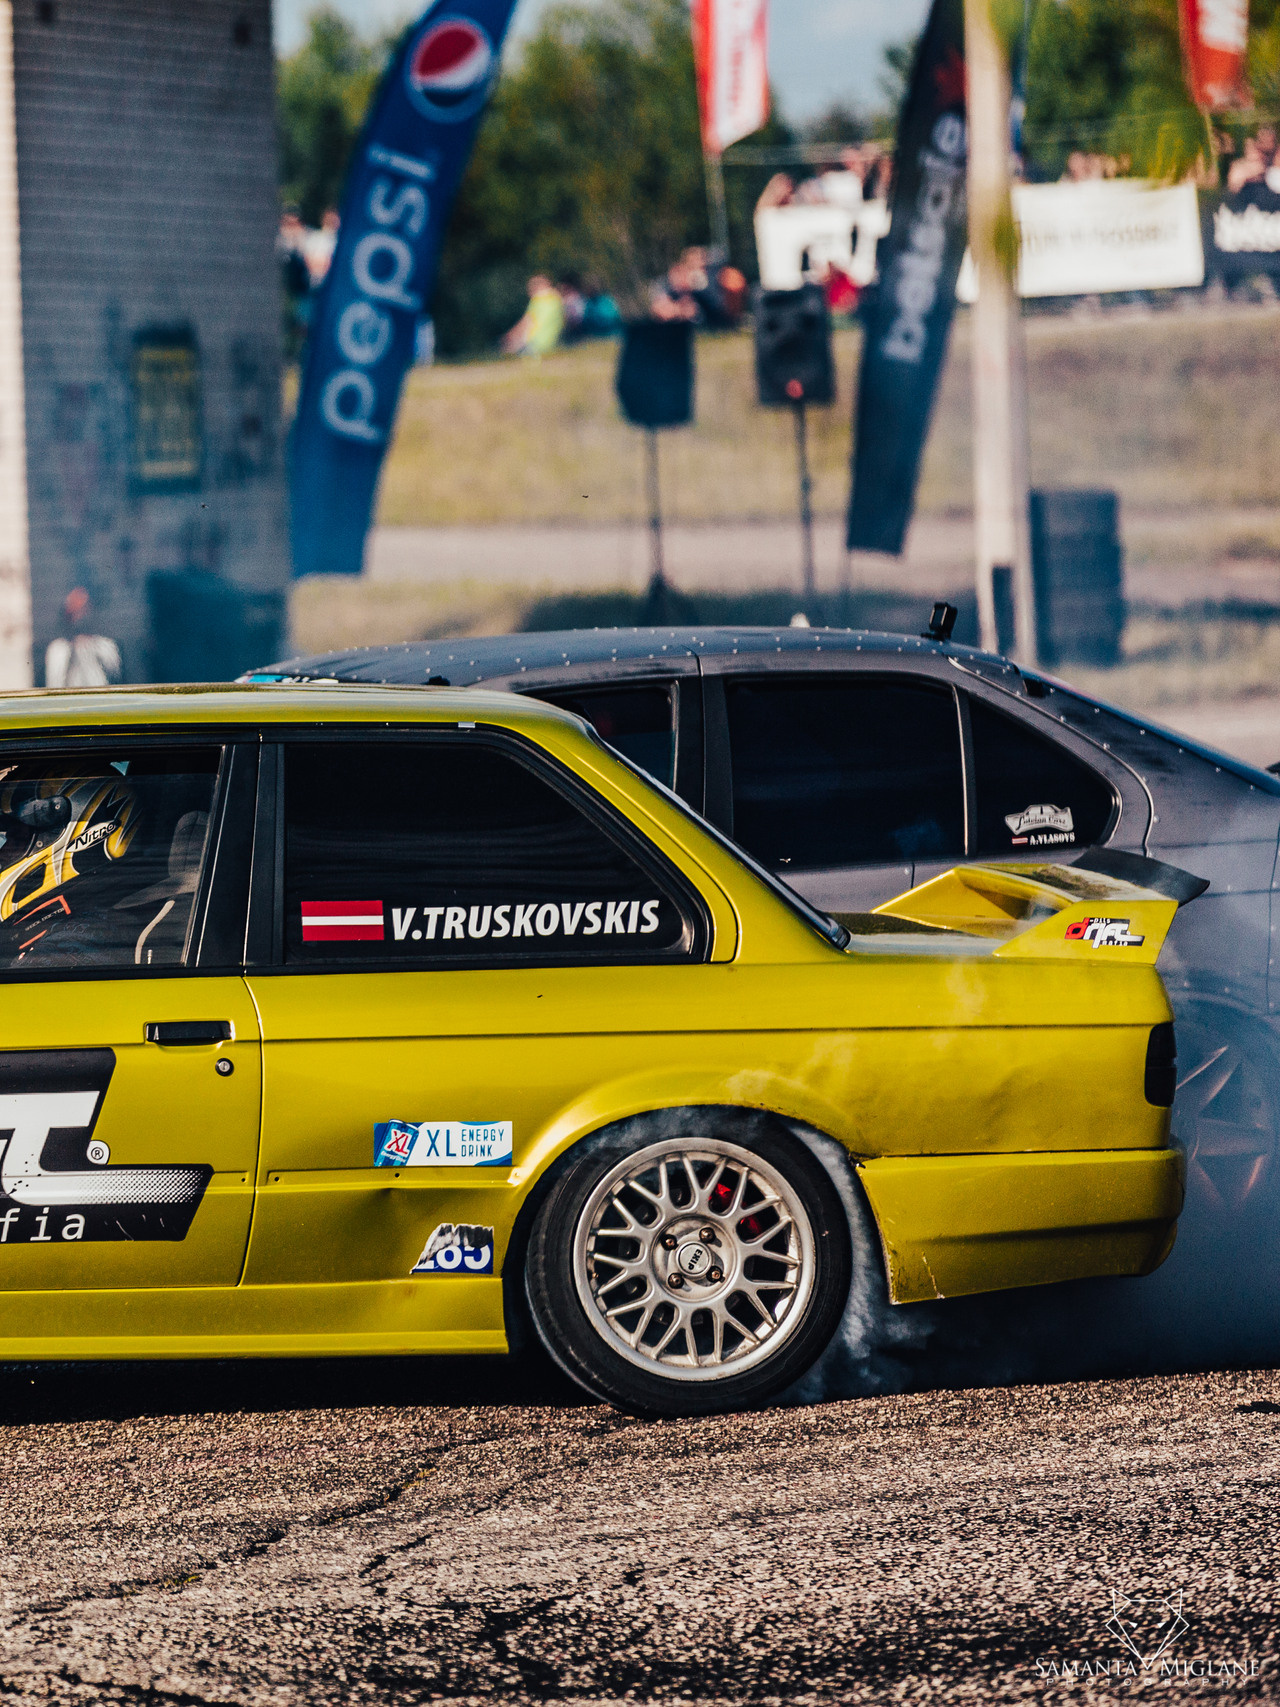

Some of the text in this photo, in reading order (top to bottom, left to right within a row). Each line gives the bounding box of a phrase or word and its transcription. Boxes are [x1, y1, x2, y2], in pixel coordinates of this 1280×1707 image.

[321, 144, 433, 441] pepsi
[75, 821, 116, 849] Nitro
[392, 900, 660, 940] V.TRUSKOVSKIS
[426, 1128, 505, 1157] XL ENERGY
[461, 1144, 493, 1157] DRINK
[415, 1245, 491, 1270] 85
